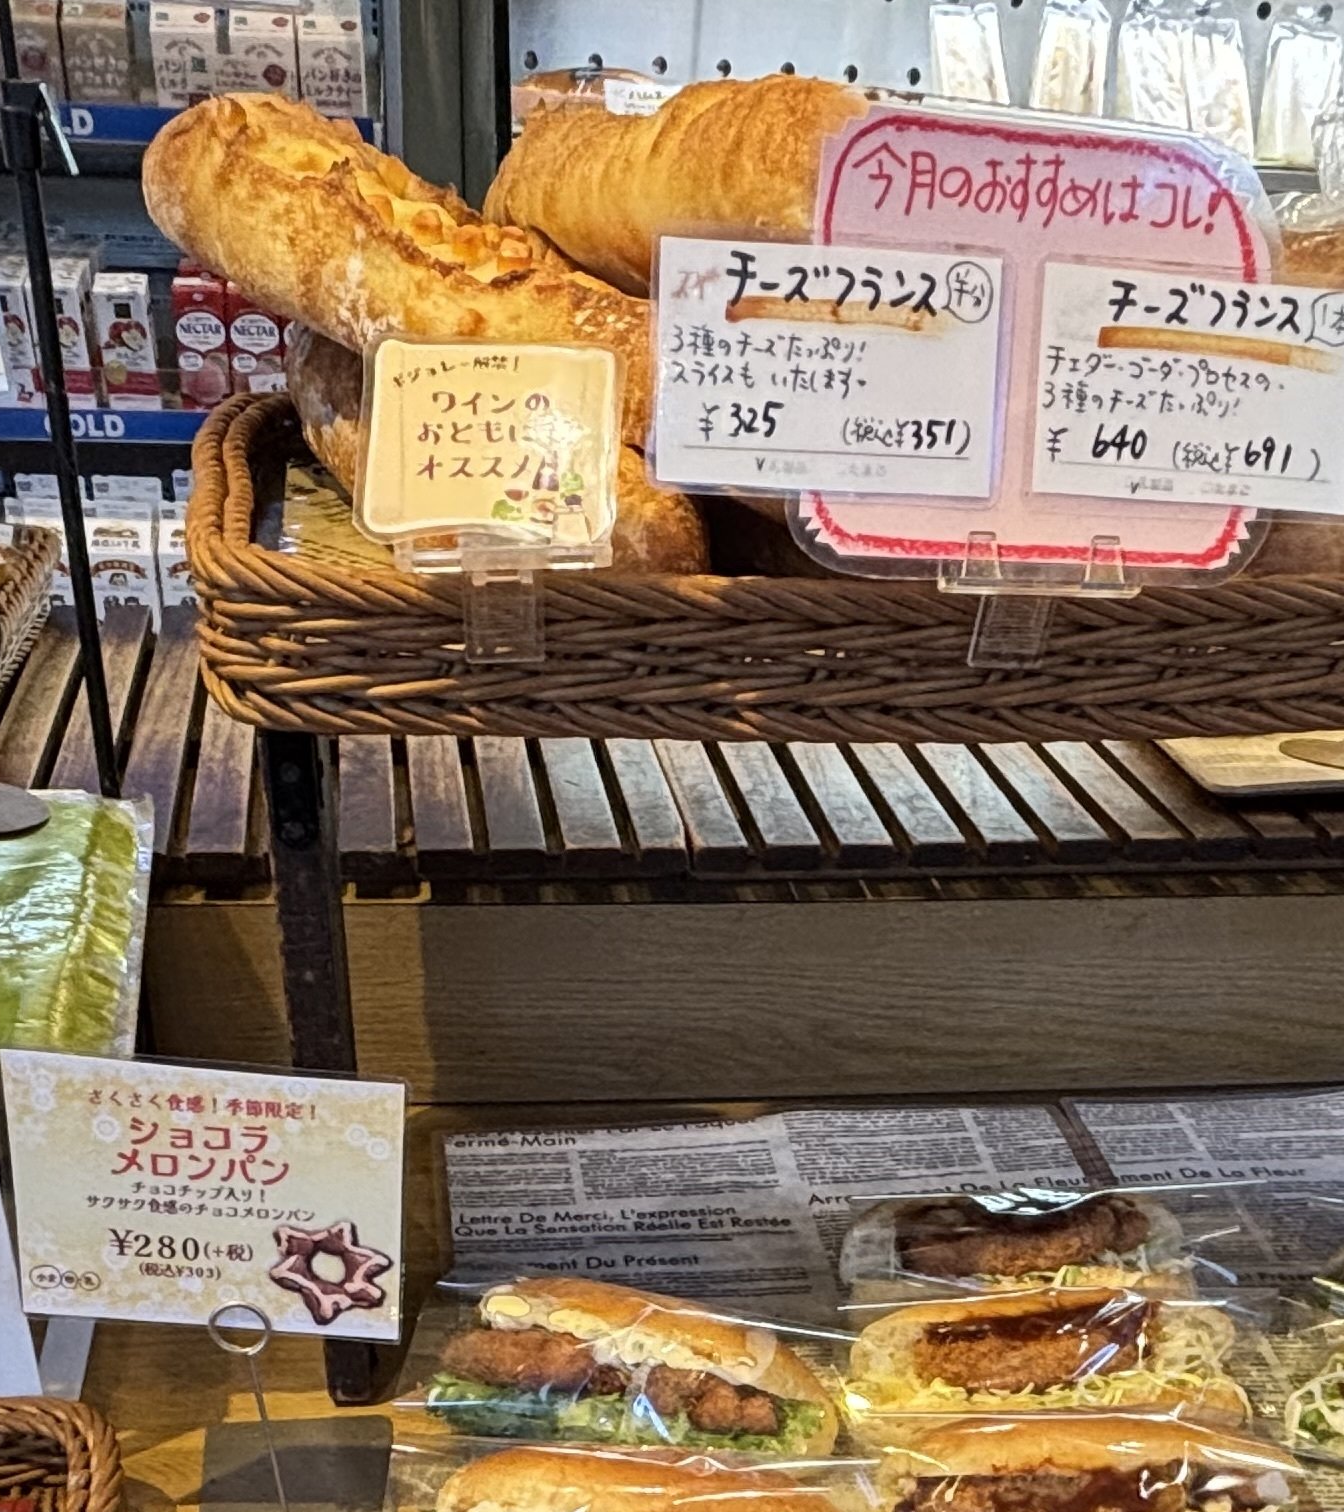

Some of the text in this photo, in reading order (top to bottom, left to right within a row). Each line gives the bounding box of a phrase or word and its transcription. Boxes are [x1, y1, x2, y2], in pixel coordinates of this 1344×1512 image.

[851, 140, 1233, 236] 今月のおすすめはコレ!
[725, 249, 938, 318] チーズフランス
[1108, 279, 1301, 336] チーズフランス
[178, 322, 222, 335] NECTAR
[233, 325, 277, 337] NECTAR
[432, 391, 551, 416] ワインの
[130, 1116, 269, 1154] ショコラ
[453, 1134, 577, 1149] ermé-Main
[110, 1148, 290, 1186] メロンパン
[1178, 1167, 1213, 1180] De
[1217, 1167, 1246, 1178] La
[1249, 1165, 1307, 1178] Fleur
[86, 1194, 316, 1223] サクサク食感のチョコメロンパン
[459, 1212, 513, 1226] Lettre
[519, 1211, 548, 1224] De
[620, 1204, 737, 1221] L'expression
[455, 1226, 498, 1239] Que
[505, 1225, 528, 1237] La
[534, 1222, 627, 1236] Sensation
[697, 1217, 725, 1230] Est
[585, 1255, 617, 1271] Du
[623, 1252, 700, 1268] Présent
